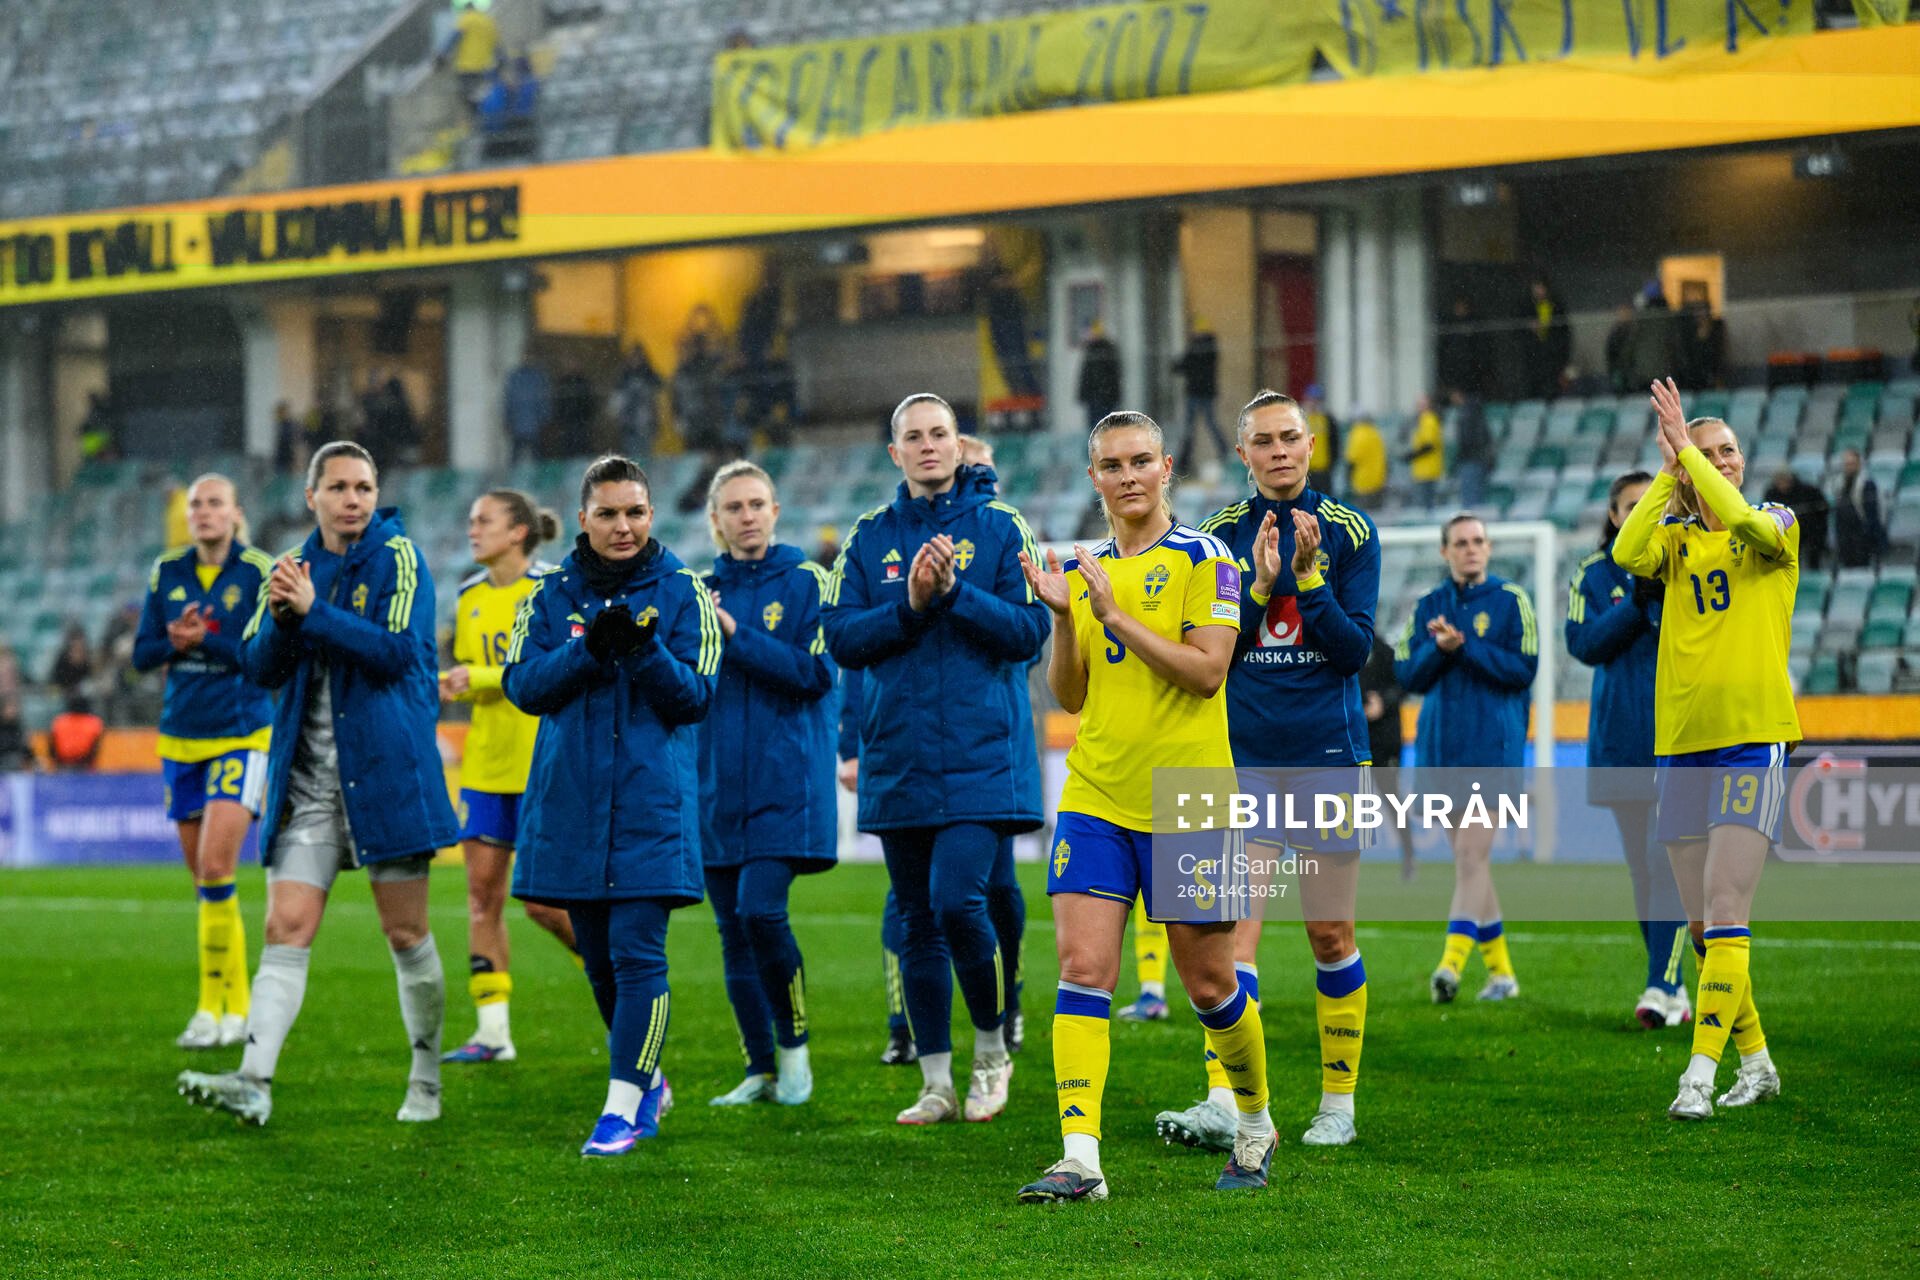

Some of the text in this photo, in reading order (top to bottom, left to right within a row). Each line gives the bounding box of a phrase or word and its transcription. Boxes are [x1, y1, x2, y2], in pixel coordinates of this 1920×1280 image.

[1690, 569, 1730, 615] 13
[481, 631, 508, 667] 16
[1243, 651, 1293, 663] VENSKA
[206, 757, 244, 796] 22
[1721, 774, 1758, 815] 13
